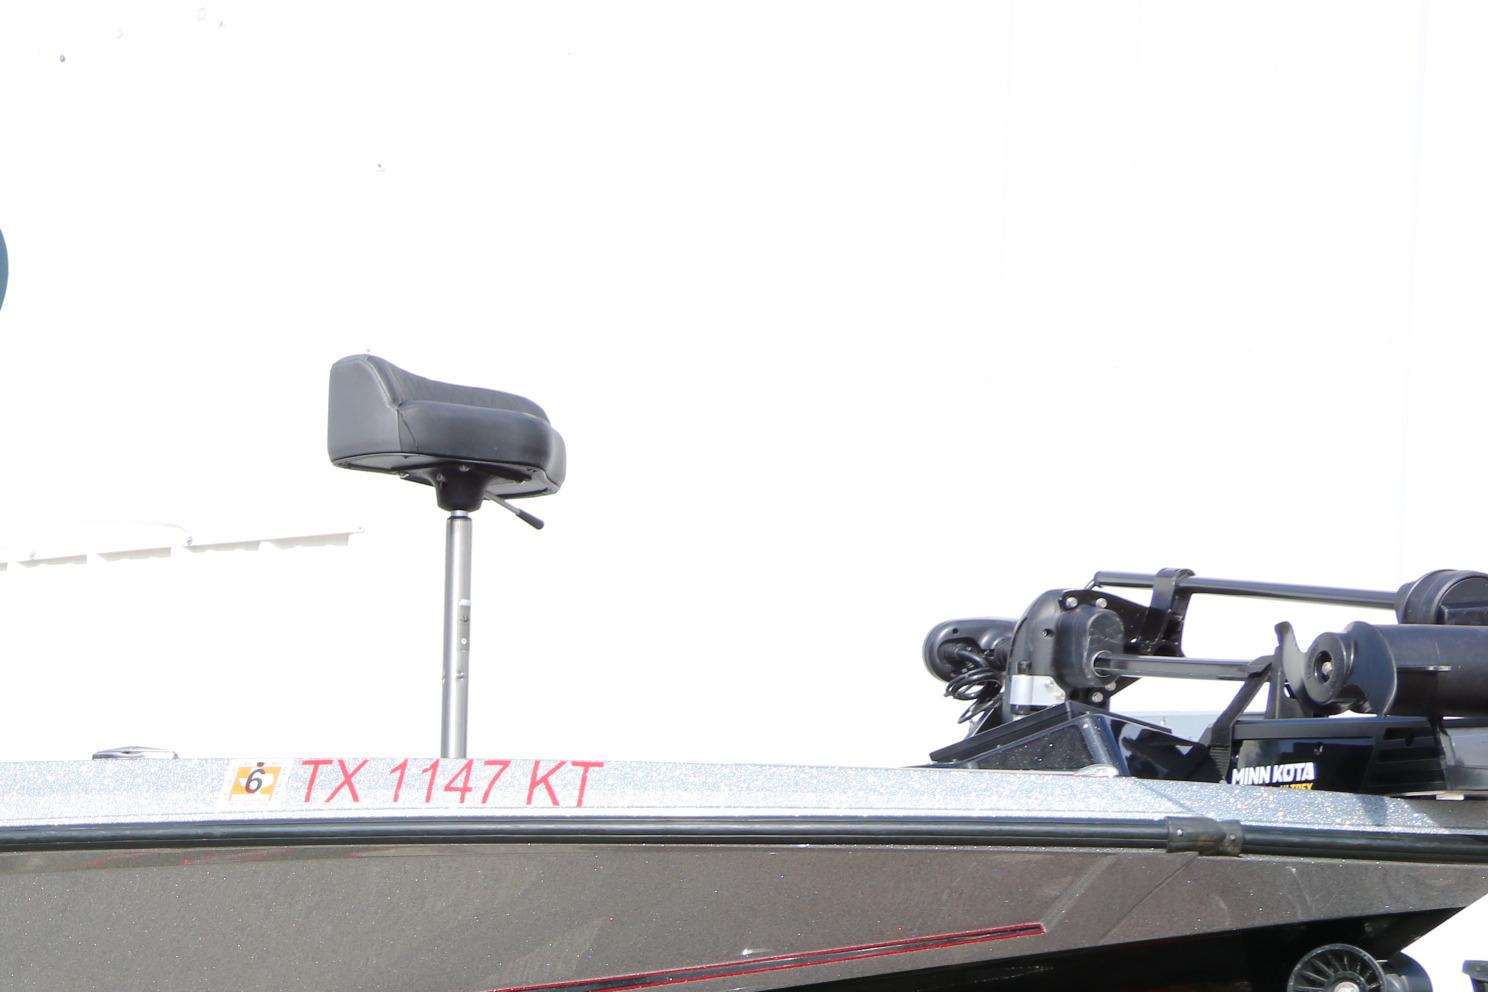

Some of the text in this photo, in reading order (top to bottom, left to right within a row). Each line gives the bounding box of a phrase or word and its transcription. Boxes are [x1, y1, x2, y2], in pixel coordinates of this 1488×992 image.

[302, 757, 605, 808] TX 1147 KT
[1231, 761, 1316, 785] MINN KOTA
